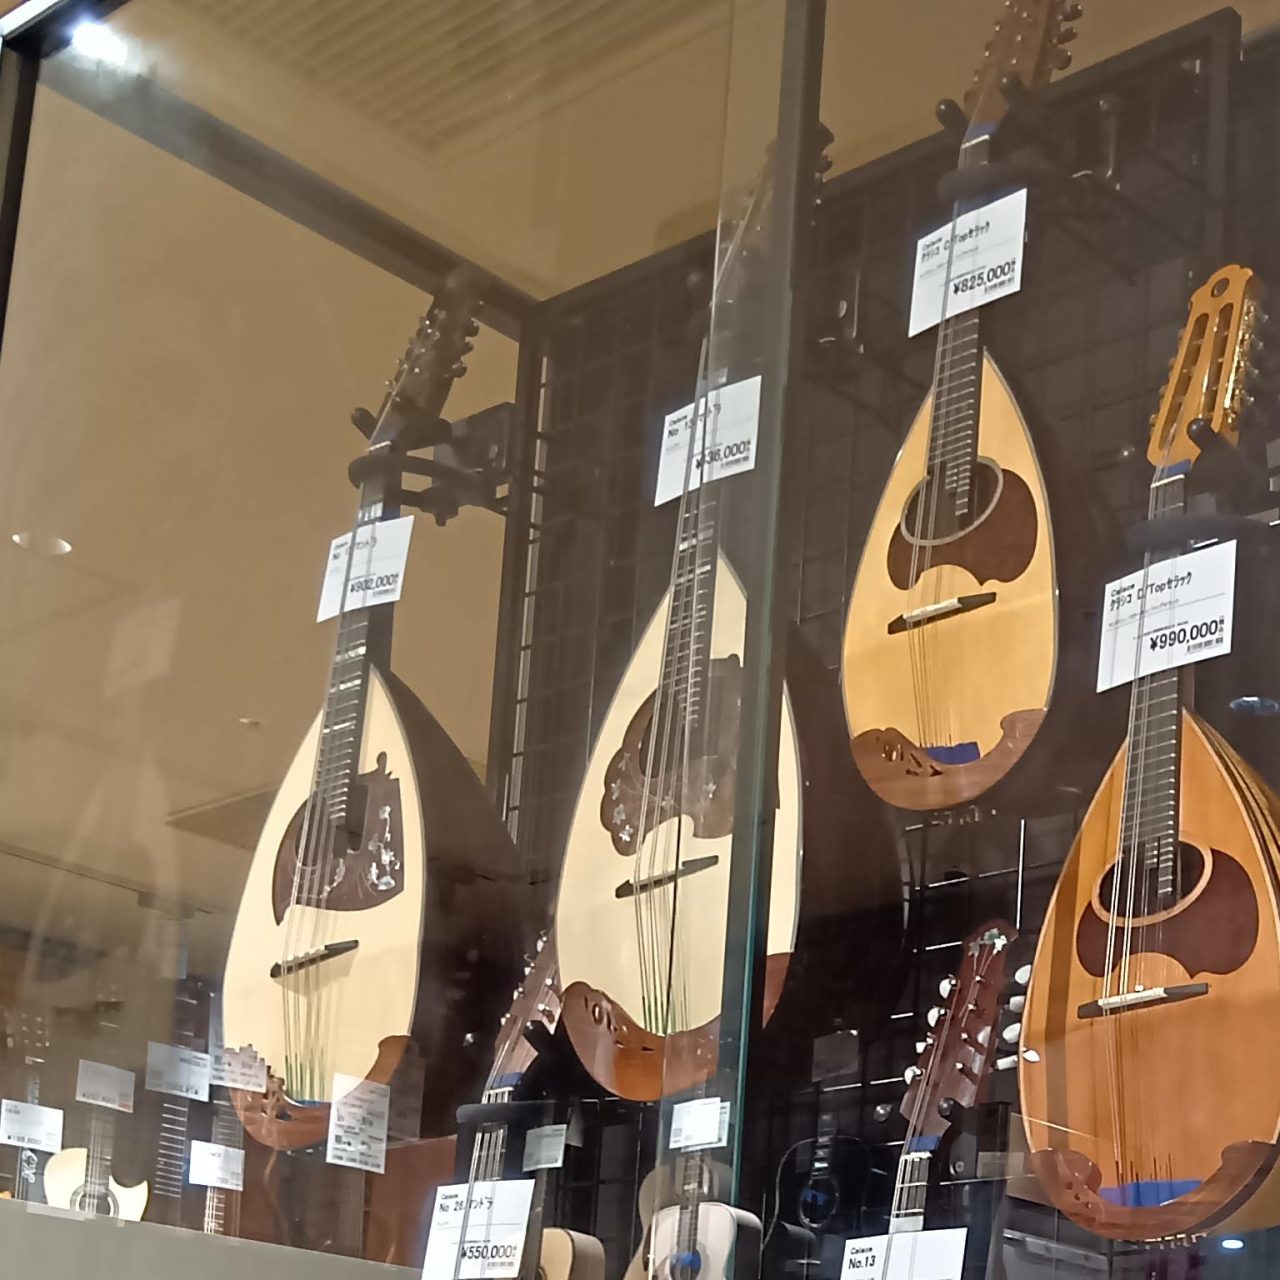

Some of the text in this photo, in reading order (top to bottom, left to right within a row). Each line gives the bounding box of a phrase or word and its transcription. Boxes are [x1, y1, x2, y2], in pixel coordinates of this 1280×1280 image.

[953, 262, 1012, 295] ¥825,000
[695, 440, 746, 470] ¥36,000
[1150, 619, 1218, 651] ¥990,000
[461, 1245, 513, 1260] ¥550,000
[848, 1255, 876, 1269] No.13
